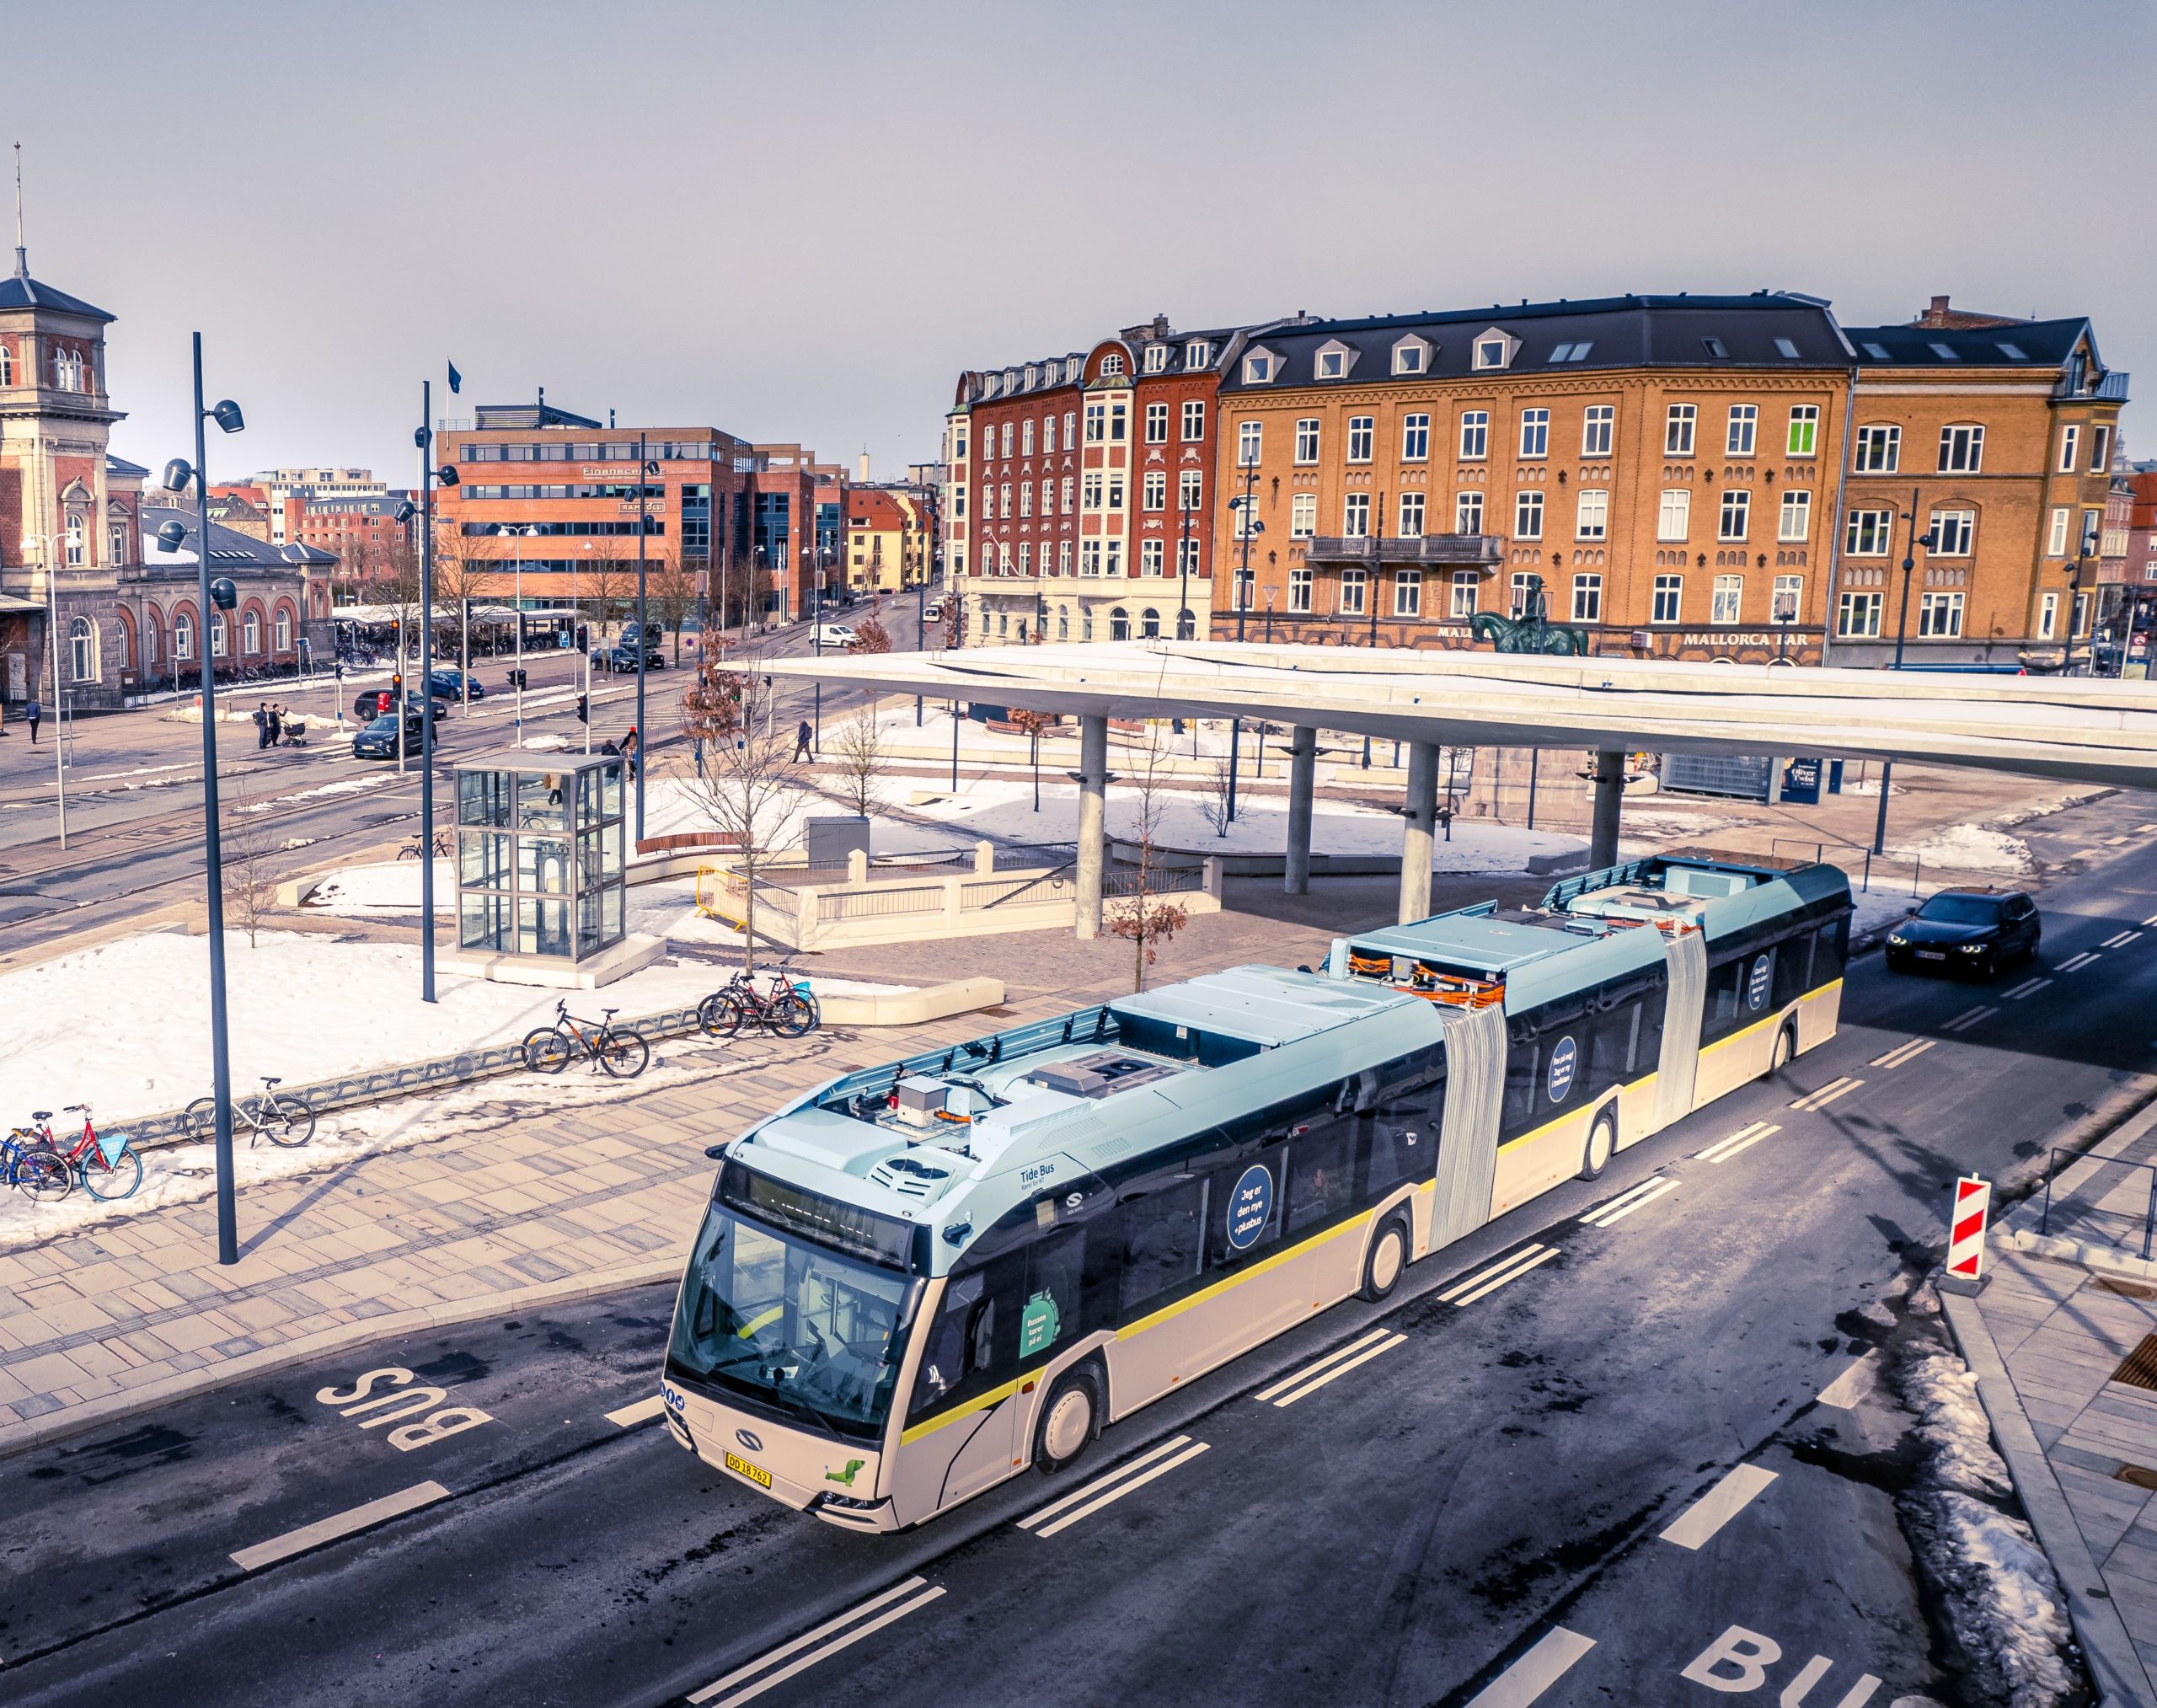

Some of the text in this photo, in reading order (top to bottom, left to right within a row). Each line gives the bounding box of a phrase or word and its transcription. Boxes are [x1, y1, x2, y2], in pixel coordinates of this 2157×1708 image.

[623, 503, 661, 511] RAMØLL
[1683, 634, 1770, 645] MALLORCA
[1791, 768, 1816, 777] Oliver
[1793, 774, 1815, 783] Twist
[1020, 1164, 1055, 1183] Tide Bus
[1241, 1185, 1262, 1201] Jeg er
[1237, 1200, 1263, 1218] den nye
[1027, 1314, 1046, 1327] Bussen
[1029, 1325, 1044, 1336] kører
[1029, 1336, 1036, 1347] på
[316, 1368, 494, 1452] BUS
[730, 1456, 768, 1484] DD 18 762
[1680, 1625, 1946, 1708] BU
